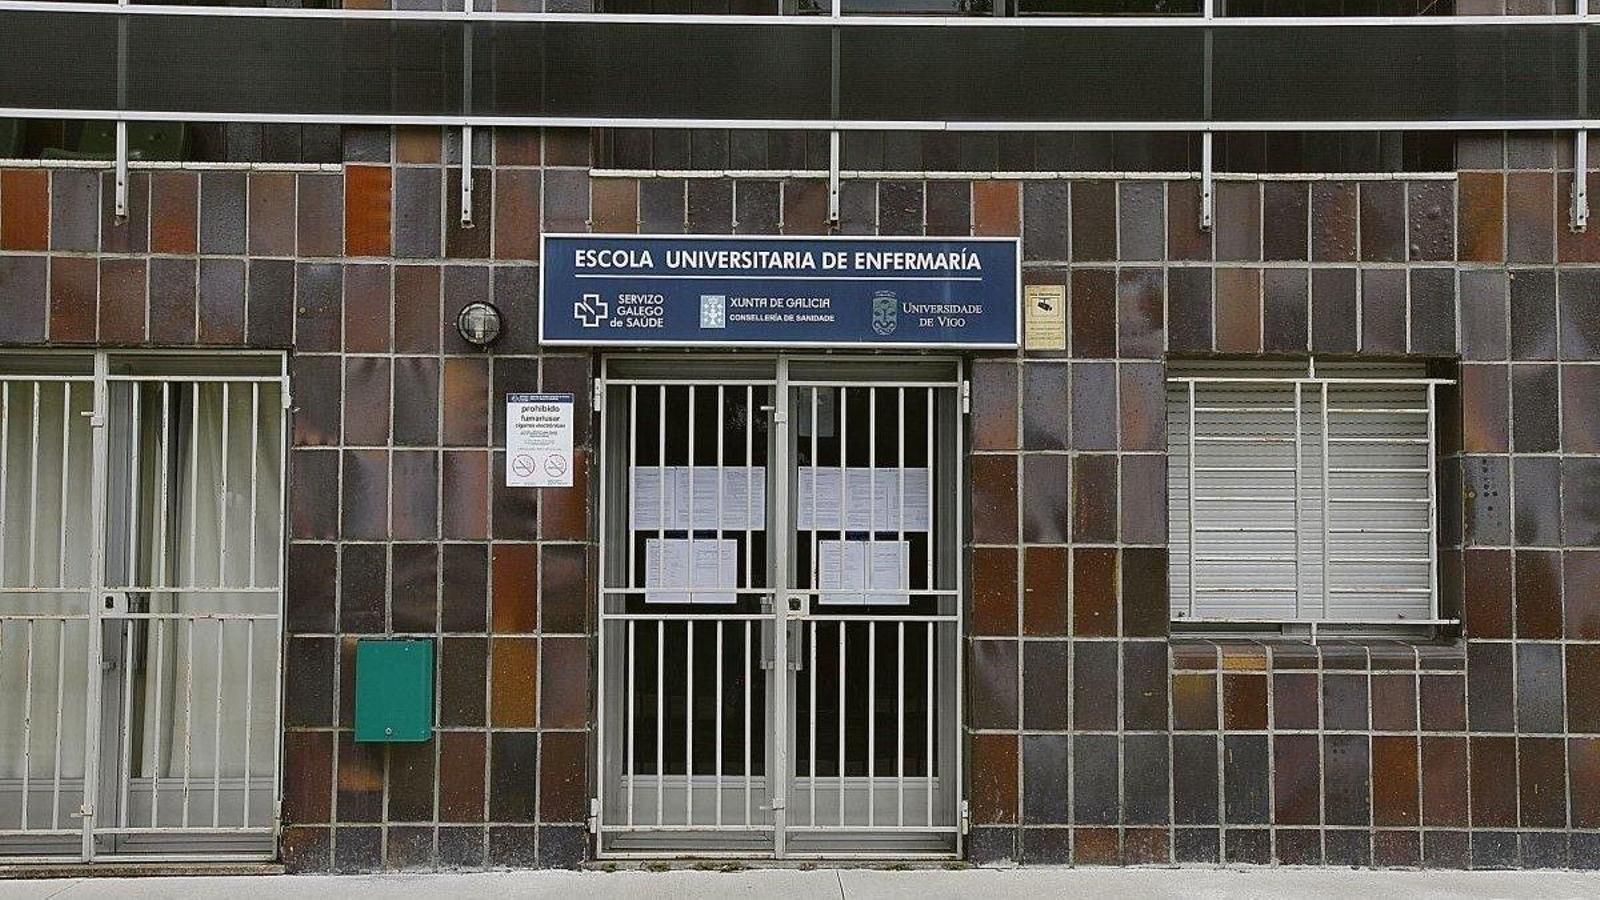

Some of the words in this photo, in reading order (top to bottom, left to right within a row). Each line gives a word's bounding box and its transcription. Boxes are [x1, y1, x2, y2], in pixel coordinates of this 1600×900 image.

[574, 249, 654, 269] ESCOLA
[665, 250, 816, 270] UNIVERSITARIA
[822, 252, 848, 270] DE
[854, 248, 982, 271] ENFERMARÍA
[617, 294, 664, 305] SERVIZO
[730, 297, 768, 309] XUNTA
[771, 298, 784, 309] DE
[786, 298, 830, 310] GALICIA
[616, 305, 664, 317] GALEGO
[903, 303, 983, 315] UNIVERSIDADE
[609, 318, 624, 328] de
[626, 315, 664, 328] SAÚDE
[729, 313, 782, 322] CONSELLERÍA
[783, 314, 794, 322] DE
[795, 314, 835, 322] SANIDADE
[937, 316, 966, 328] VIGO
[521, 405, 560, 413] prohibido
